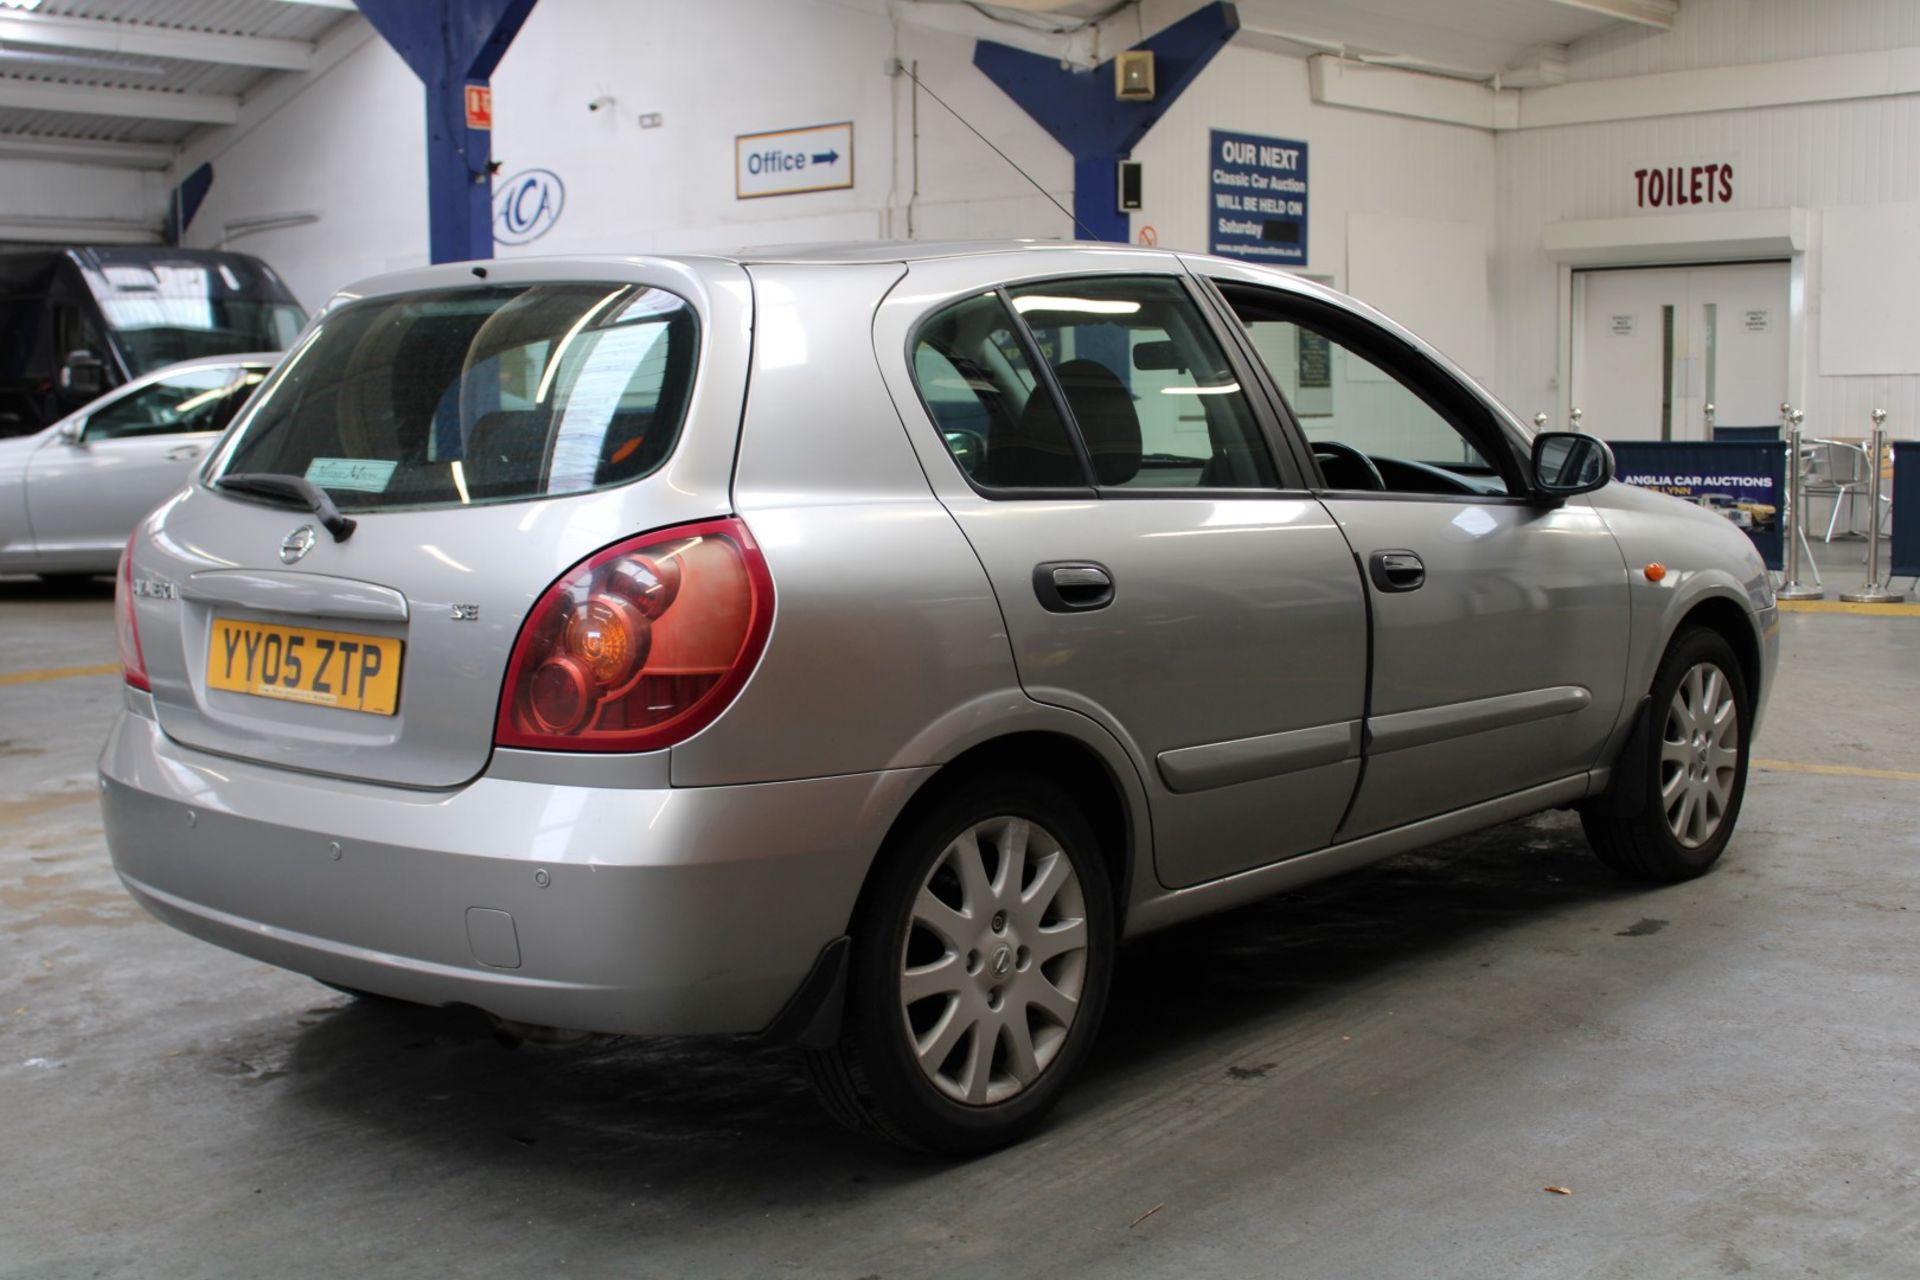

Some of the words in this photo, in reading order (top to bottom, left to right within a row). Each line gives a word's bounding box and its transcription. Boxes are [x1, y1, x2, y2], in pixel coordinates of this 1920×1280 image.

[748, 151, 805, 174] Office
[1222, 140, 1256, 165] OUR
[1260, 145, 1299, 170] NEXT
[1212, 168, 1249, 187] Classic
[1251, 173, 1268, 189] Car
[1270, 176, 1305, 192] Auction
[1634, 163, 1733, 208] TOILETS
[1216, 193, 1242, 210] WILL
[1243, 196, 1258, 212] BE
[1260, 198, 1286, 214] HELD
[1287, 201, 1303, 215] ON
[1218, 218, 1263, 239] Saturday
[1625, 475, 1670, 487] ANGLIA
[1674, 475, 1702, 487] CAR
[1703, 476, 1773, 488] AUCTIONS
[224, 627, 305, 688] YY05
[312, 638, 382, 698] ZTP
